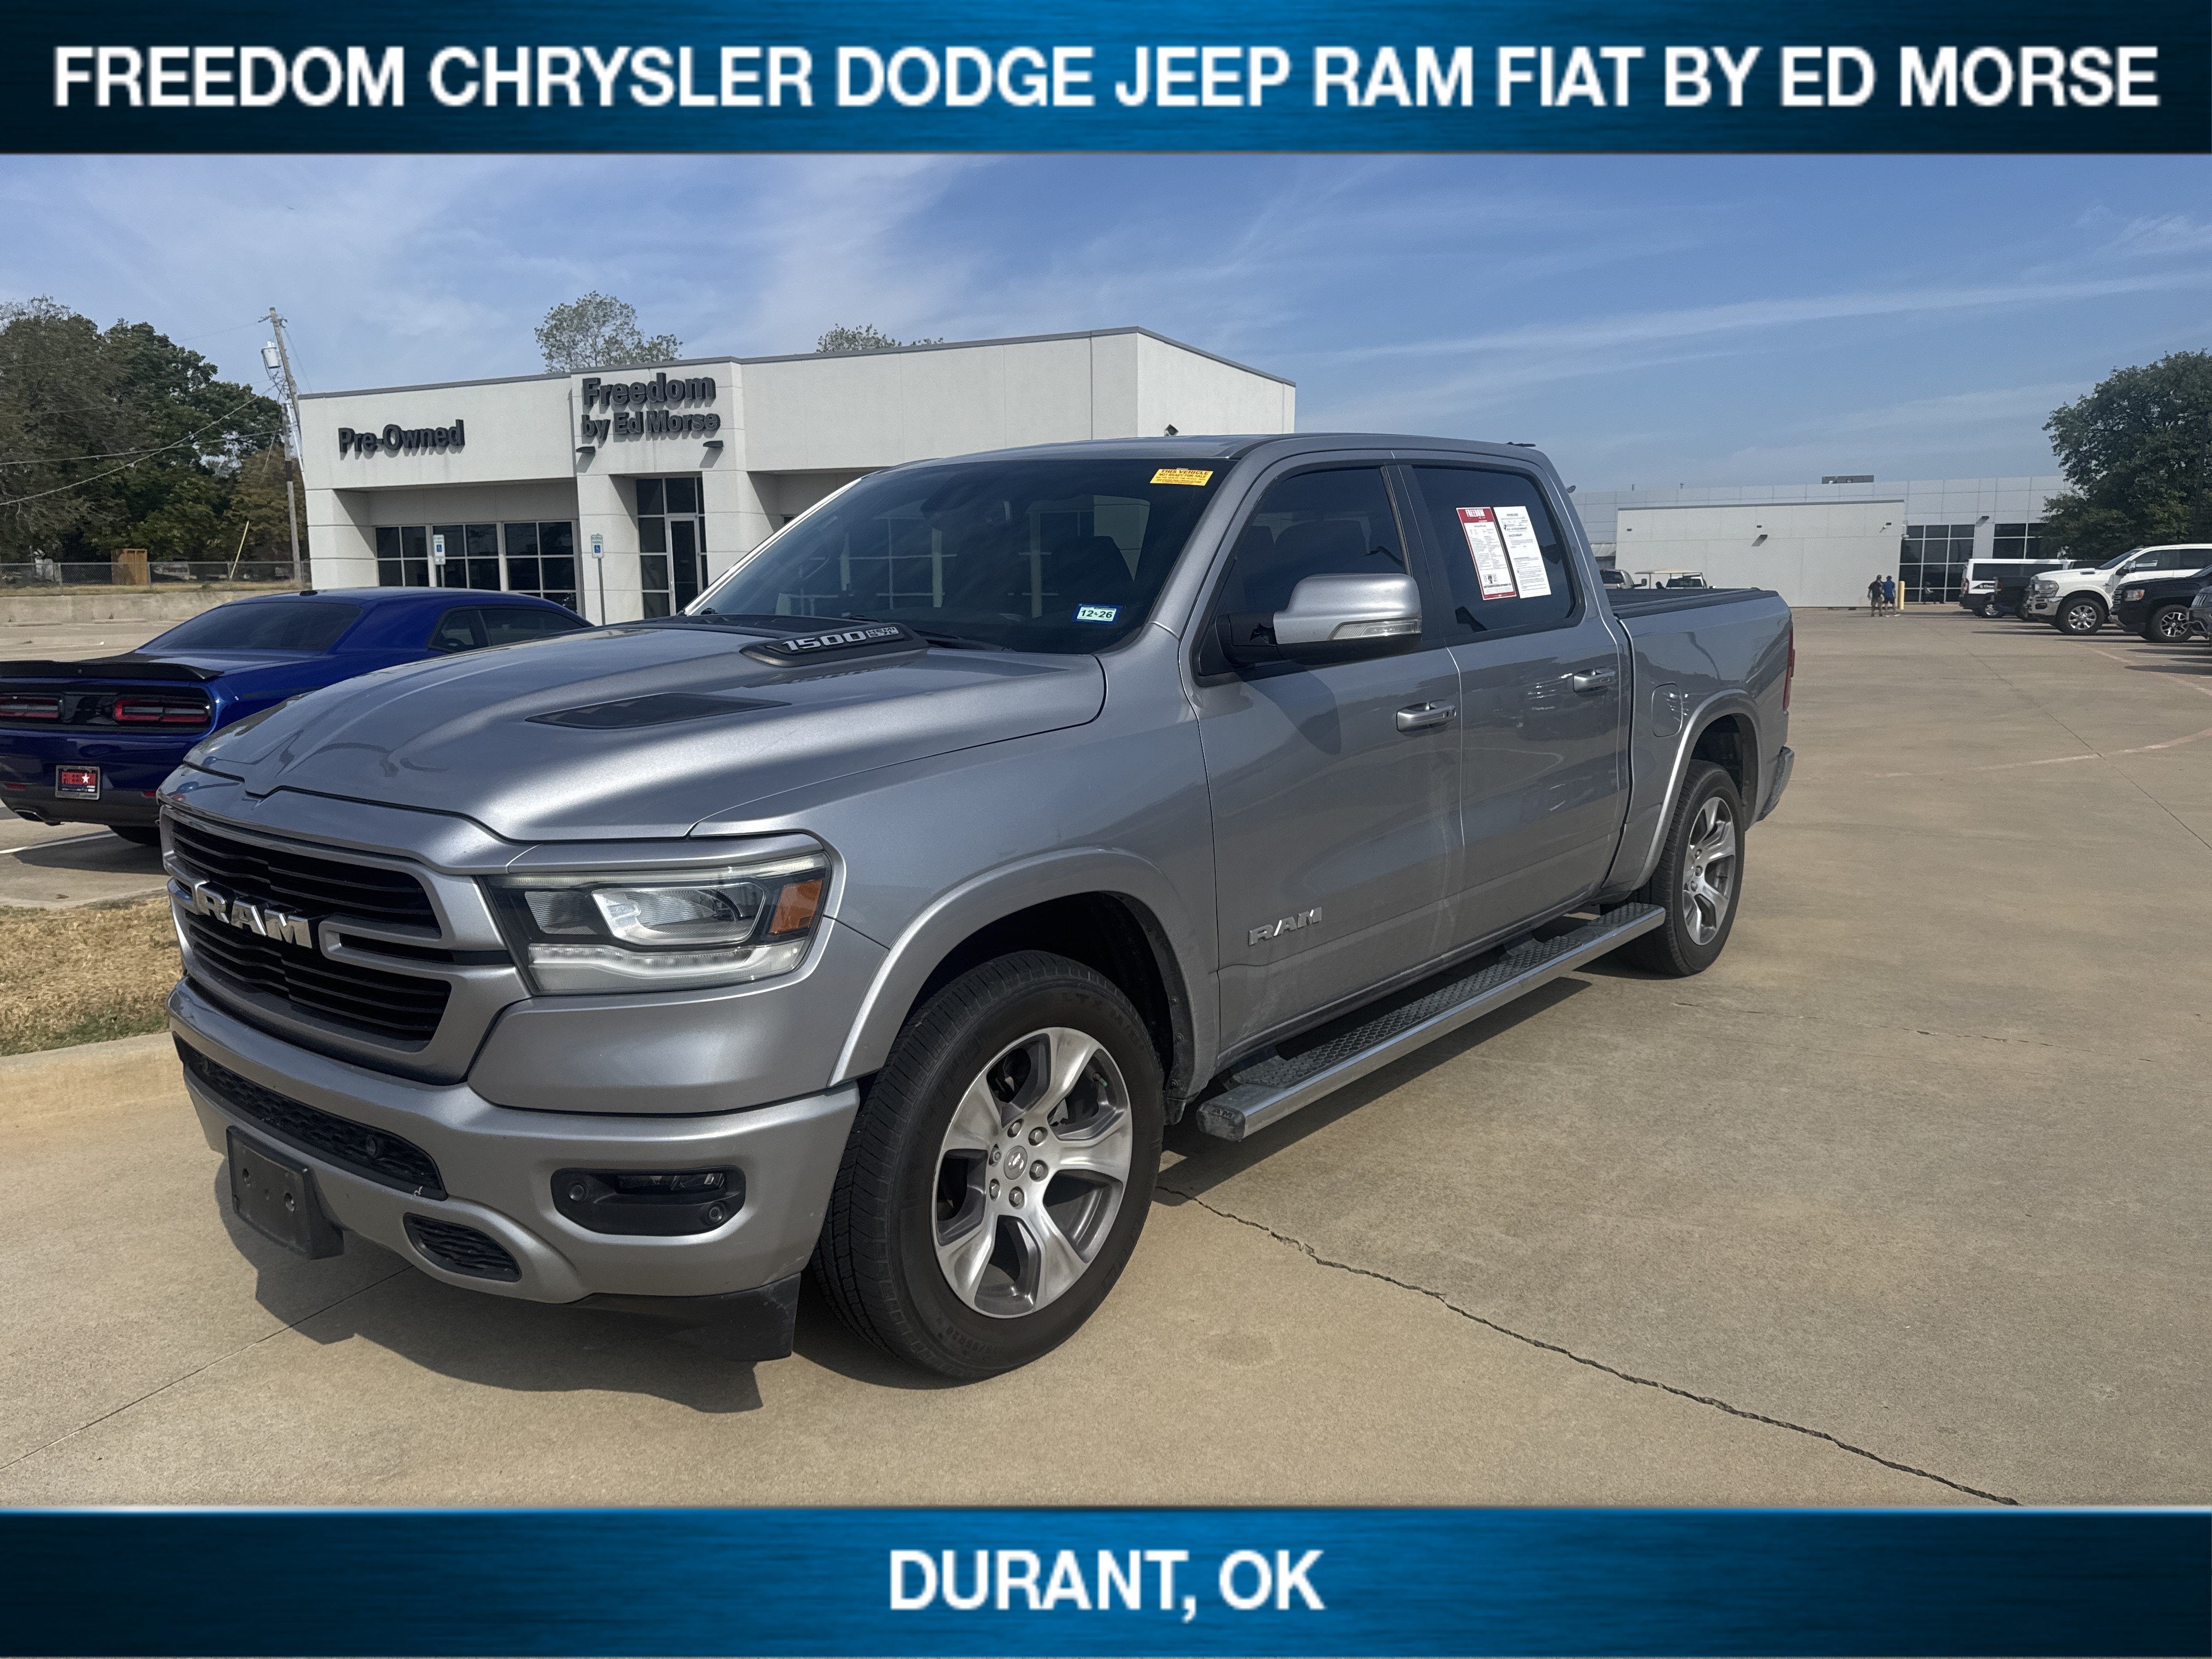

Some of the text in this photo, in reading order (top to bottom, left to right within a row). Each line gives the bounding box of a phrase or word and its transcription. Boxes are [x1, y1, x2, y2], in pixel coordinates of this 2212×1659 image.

[582, 372, 716, 405] Freedom
[338, 420, 466, 453] Pre-Owned
[582, 410, 720, 443] by Ed Morse
[781, 631, 866, 651] 1500
[196, 881, 313, 949] RAM
[1248, 906, 1322, 946] RAM
